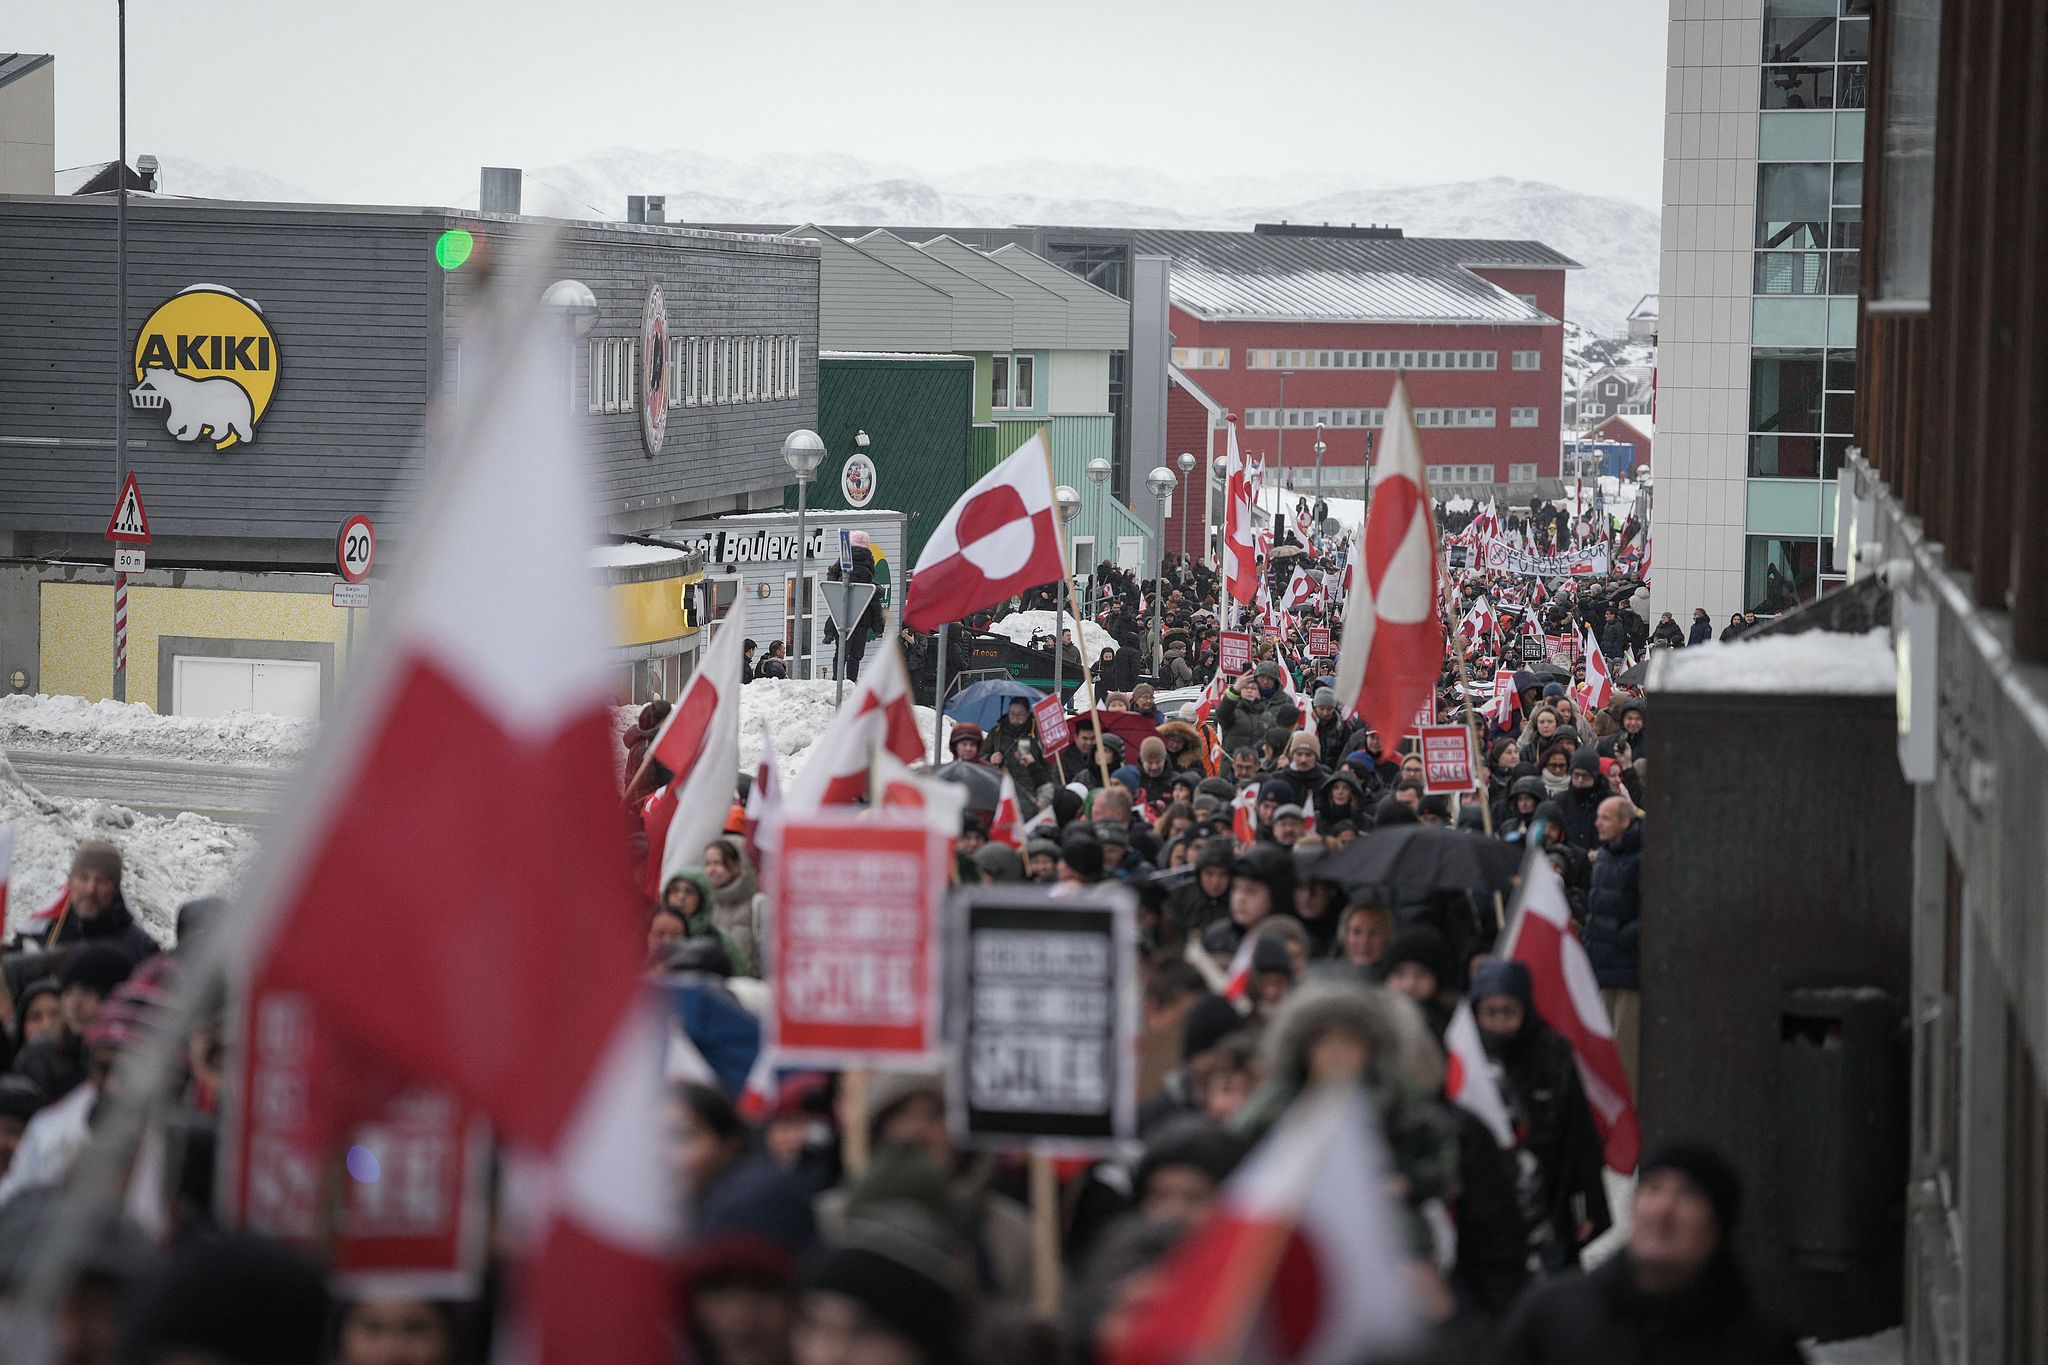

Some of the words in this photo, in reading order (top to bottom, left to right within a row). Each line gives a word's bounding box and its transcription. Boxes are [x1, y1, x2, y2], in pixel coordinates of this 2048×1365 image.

[138, 334, 270, 371] AKIKI
[346, 535, 370, 562] 20
[1579, 543, 1606, 559] OUR
[120, 555, 131, 565] 50
[1507, 555, 1568, 575] FUTURE
[1224, 656, 1244, 672] SALE
